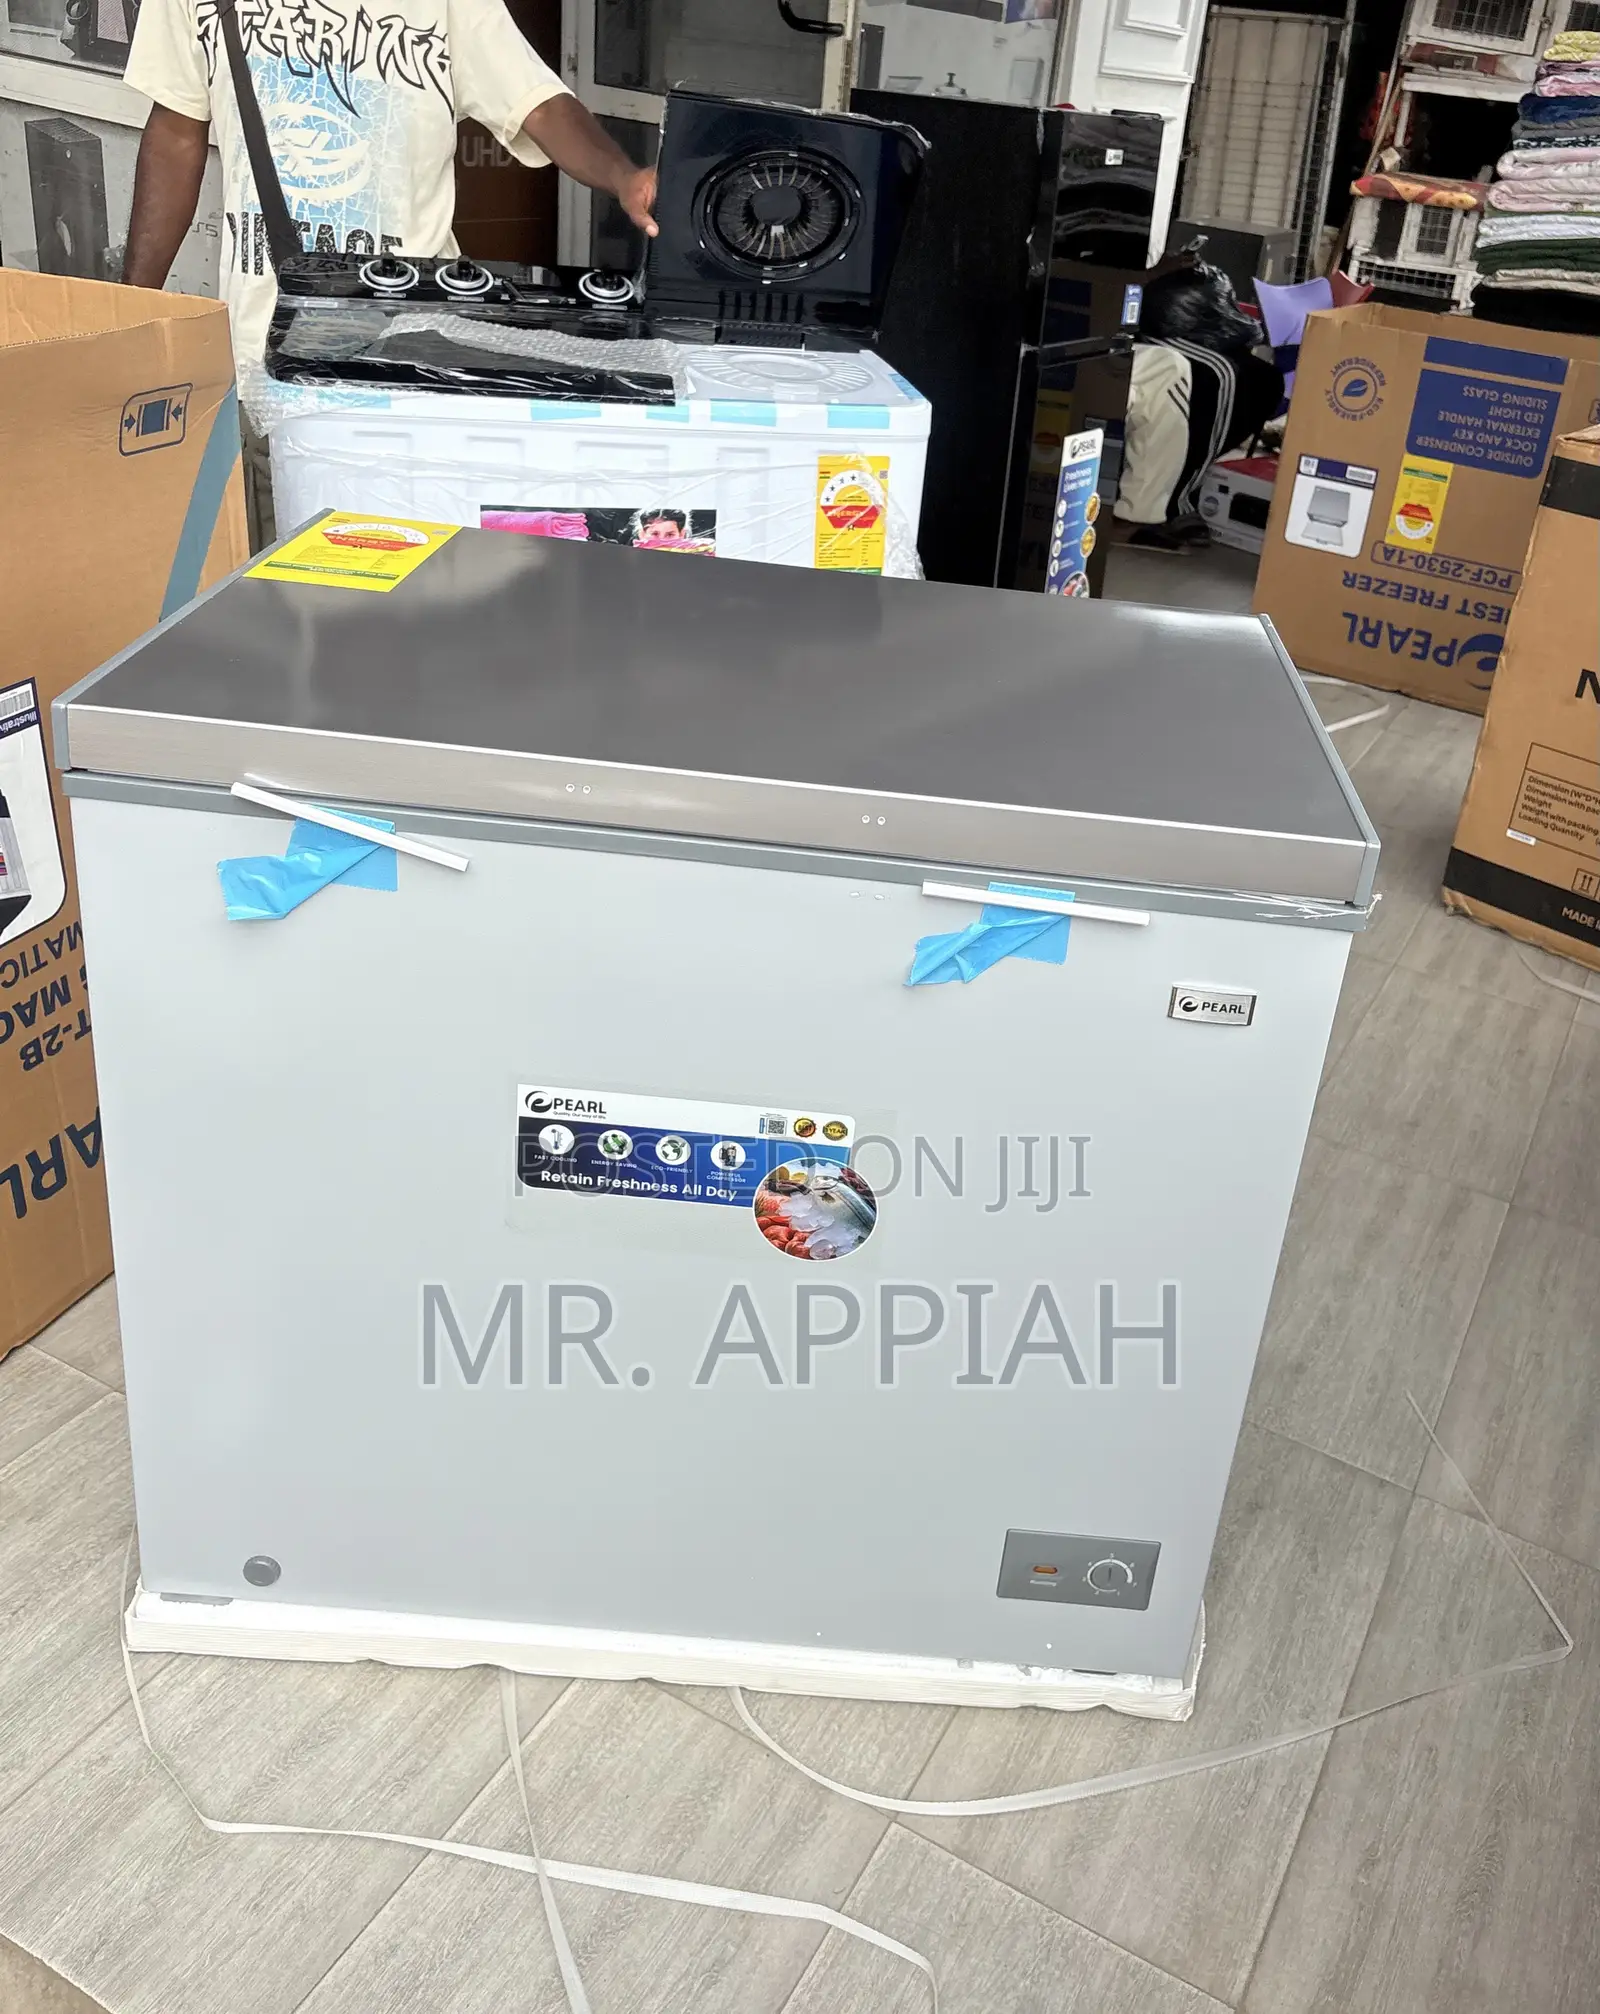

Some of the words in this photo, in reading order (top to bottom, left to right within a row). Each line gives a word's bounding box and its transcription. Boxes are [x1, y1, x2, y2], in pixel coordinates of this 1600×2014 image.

[225, 211, 403, 276] VINTA
[1462, 385, 1499, 401] GLASS
[1502, 392, 1548, 410] SLIDING
[1437, 410, 1482, 427] HANDLE
[1488, 405, 1521, 419] LIGHT
[1523, 413, 1545, 424] LED
[1452, 428, 1475, 440] KEY
[1486, 420, 1541, 439] EXTERNAL
[1415, 435, 1485, 458] CONDENSER
[1476, 432, 1504, 446] AND
[1505, 437, 1537, 453] LOCK
[1486, 450, 1534, 467] OUTSIDE
[1383, 546, 1513, 589] PCF-2530-1A
[1342, 570, 1449, 611] FREEZER
[1342, 612, 1458, 668] PEARL
[1528, 775, 1569, 795] Dimension
[1524, 793, 1552, 809] Weight
[1525, 784, 1567, 804] Dimension
[1567, 800, 1586, 811] with
[1518, 811, 1549, 829] Loading
[1549, 823, 1585, 841] Quantity
[1521, 803, 1549, 818] Weight
[1549, 813, 1567, 824] with
[1566, 819, 1600, 837] packing
[1561, 906, 1596, 928] MADE
[1201, 1001, 1246, 1015] PEARL
[553, 1097, 607, 1115] PEARL
[533, 1154, 550, 1162] FAST
[550, 1155, 578, 1163] COOLING
[615, 1161, 638, 1169] SAVING
[650, 1165, 693, 1174] ECO-FRIENDLY
[541, 1170, 593, 1186] Retain
[597, 1176, 678, 1194] Freshness
[681, 1184, 702, 1196] All
[706, 1185, 738, 1202] Day
[706, 1175, 747, 1183] COMPRESSOR
